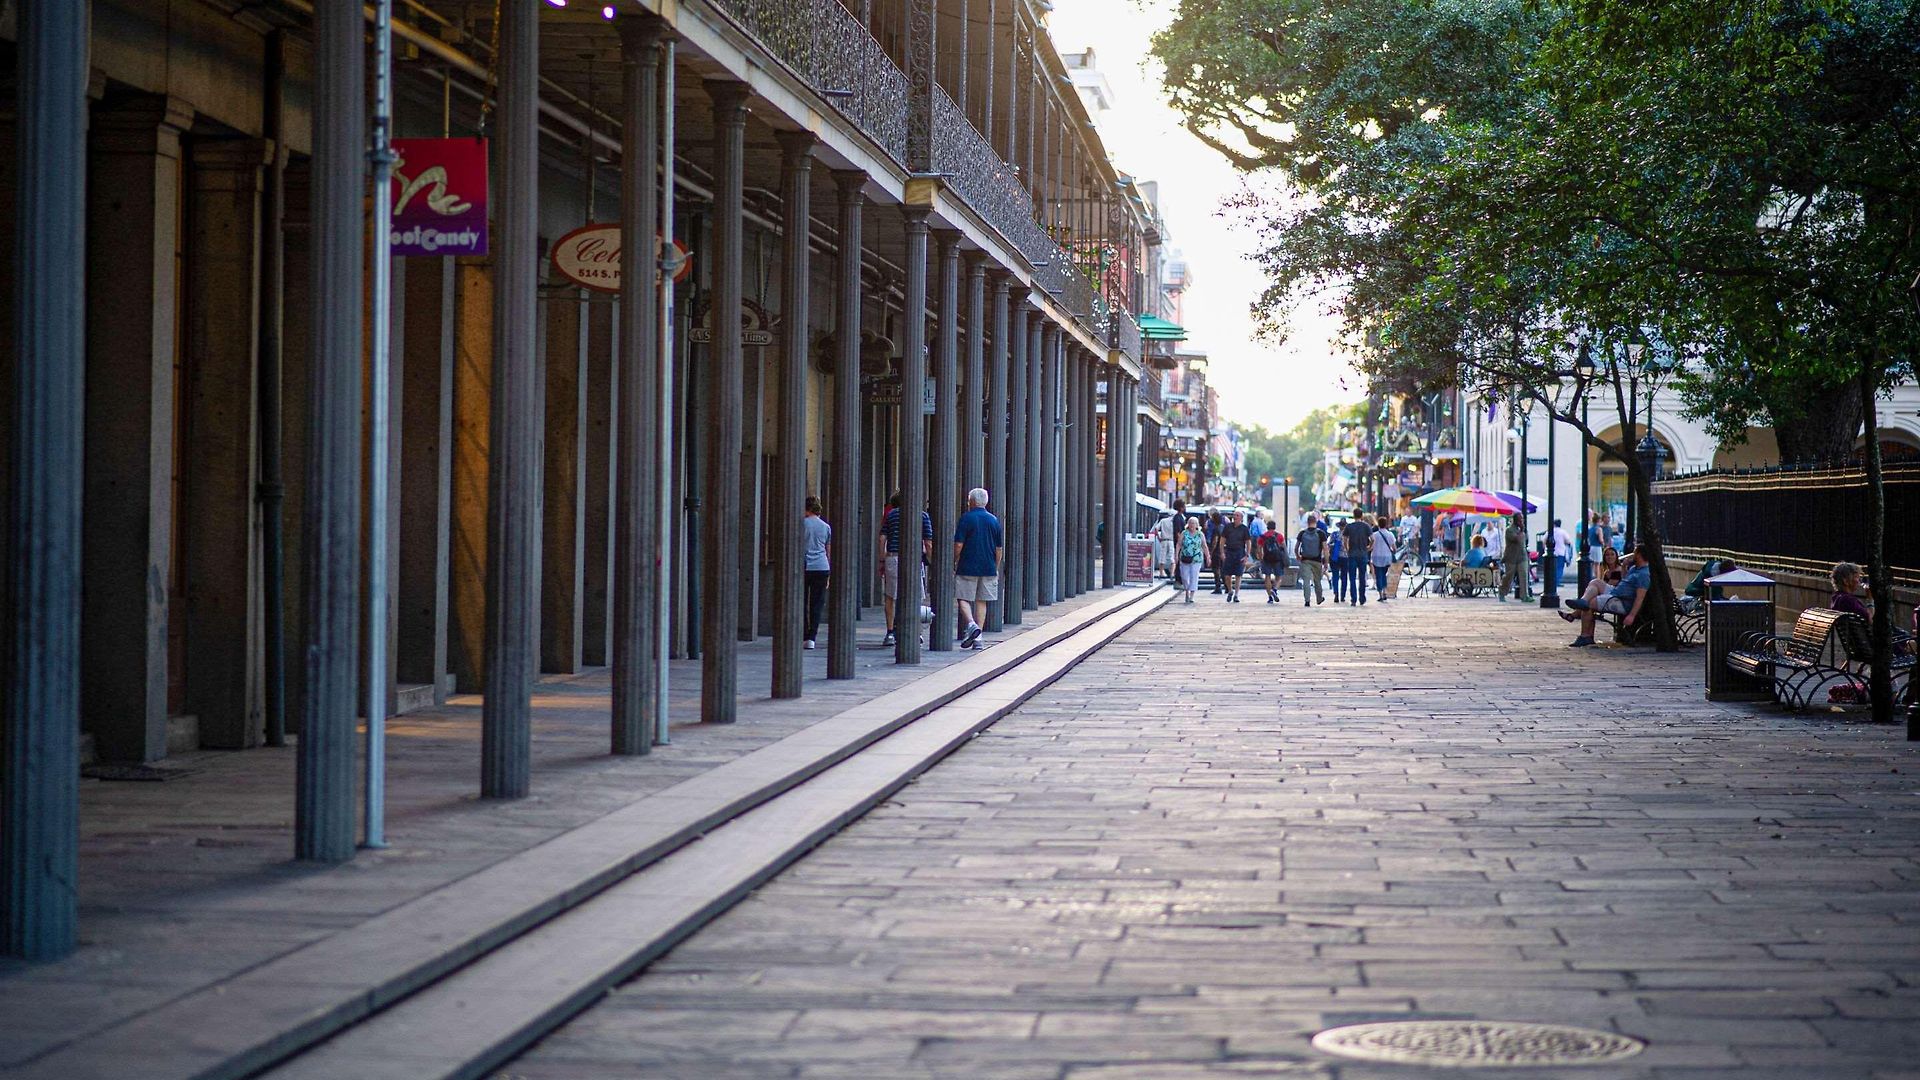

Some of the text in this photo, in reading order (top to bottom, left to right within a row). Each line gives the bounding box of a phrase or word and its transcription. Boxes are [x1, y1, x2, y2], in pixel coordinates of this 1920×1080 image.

[390, 225, 480, 251] ootCandy
[576, 238, 622, 263] Cel
[578, 269, 598, 278] 514
[601, 269, 611, 279] S.
[743, 332, 767, 343] Time
